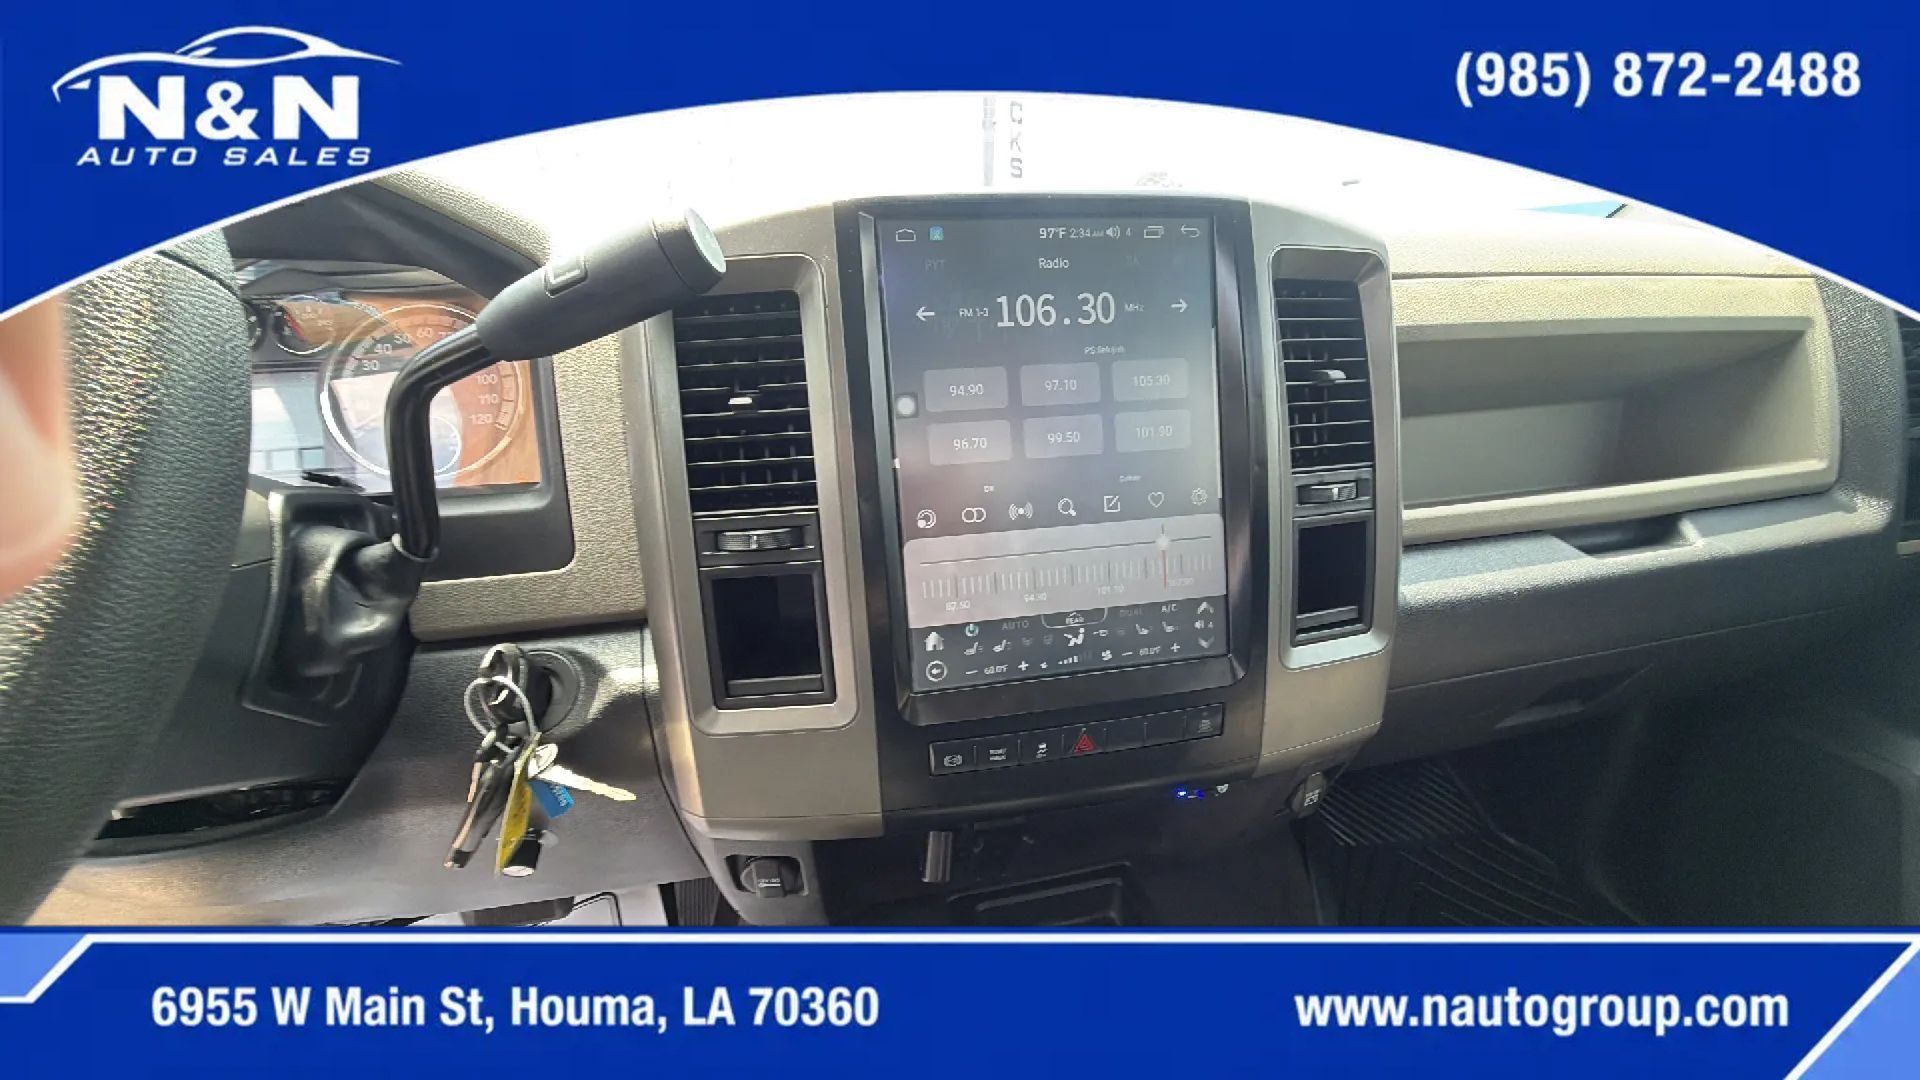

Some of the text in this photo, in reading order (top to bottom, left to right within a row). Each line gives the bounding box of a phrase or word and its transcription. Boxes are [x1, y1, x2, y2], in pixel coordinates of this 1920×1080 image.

[1038, 256, 1070, 269] Radio
[996, 291, 1116, 328] 106.30
[416, 327, 434, 338] 60
[373, 342, 393, 354] 40
[362, 359, 380, 371] 30
[474, 373, 498, 385] 100
[1043, 378, 1078, 392] 97.10
[948, 383, 985, 397] 94.90
[478, 393, 499, 405] 110
[471, 413, 493, 425] 120
[952, 437, 988, 451] 96.70
[1046, 431, 1081, 445] 99.50
[1161, 603, 1178, 613] A/C
[1001, 620, 1030, 631] AUTO
